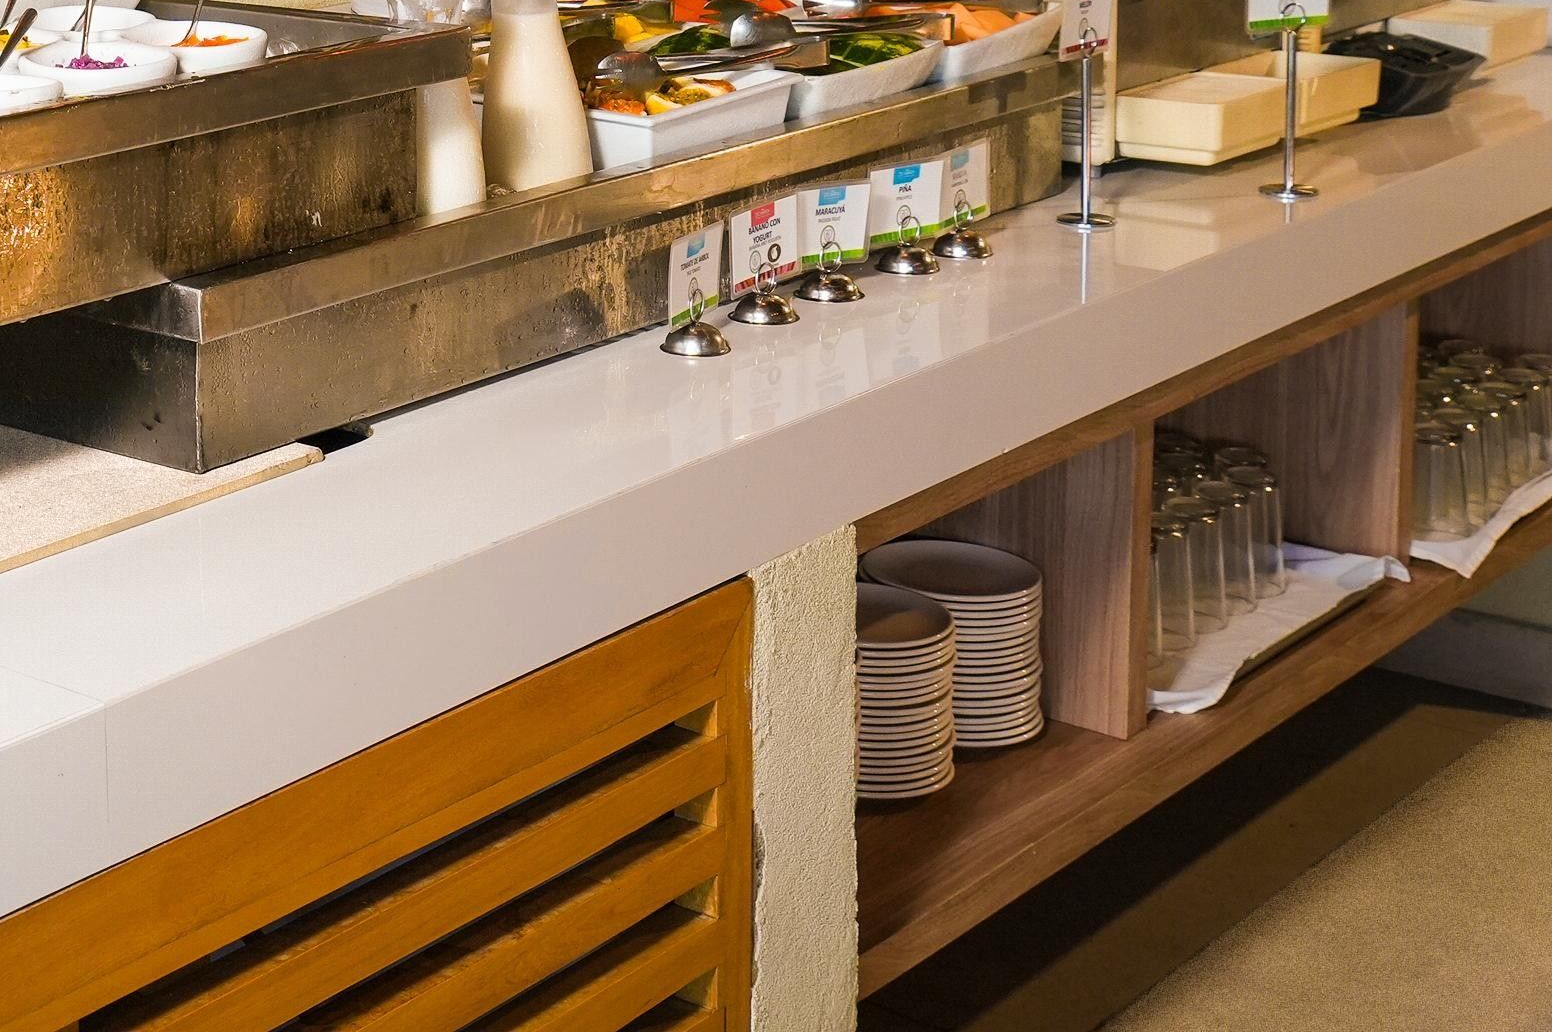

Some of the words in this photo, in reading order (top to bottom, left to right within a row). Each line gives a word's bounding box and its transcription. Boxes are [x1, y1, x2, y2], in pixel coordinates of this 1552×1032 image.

[815, 204, 846, 216] MARACUYÁ
[749, 221, 769, 235] BANANO
[769, 217, 781, 227] CON
[753, 231, 772, 243] YOGURT
